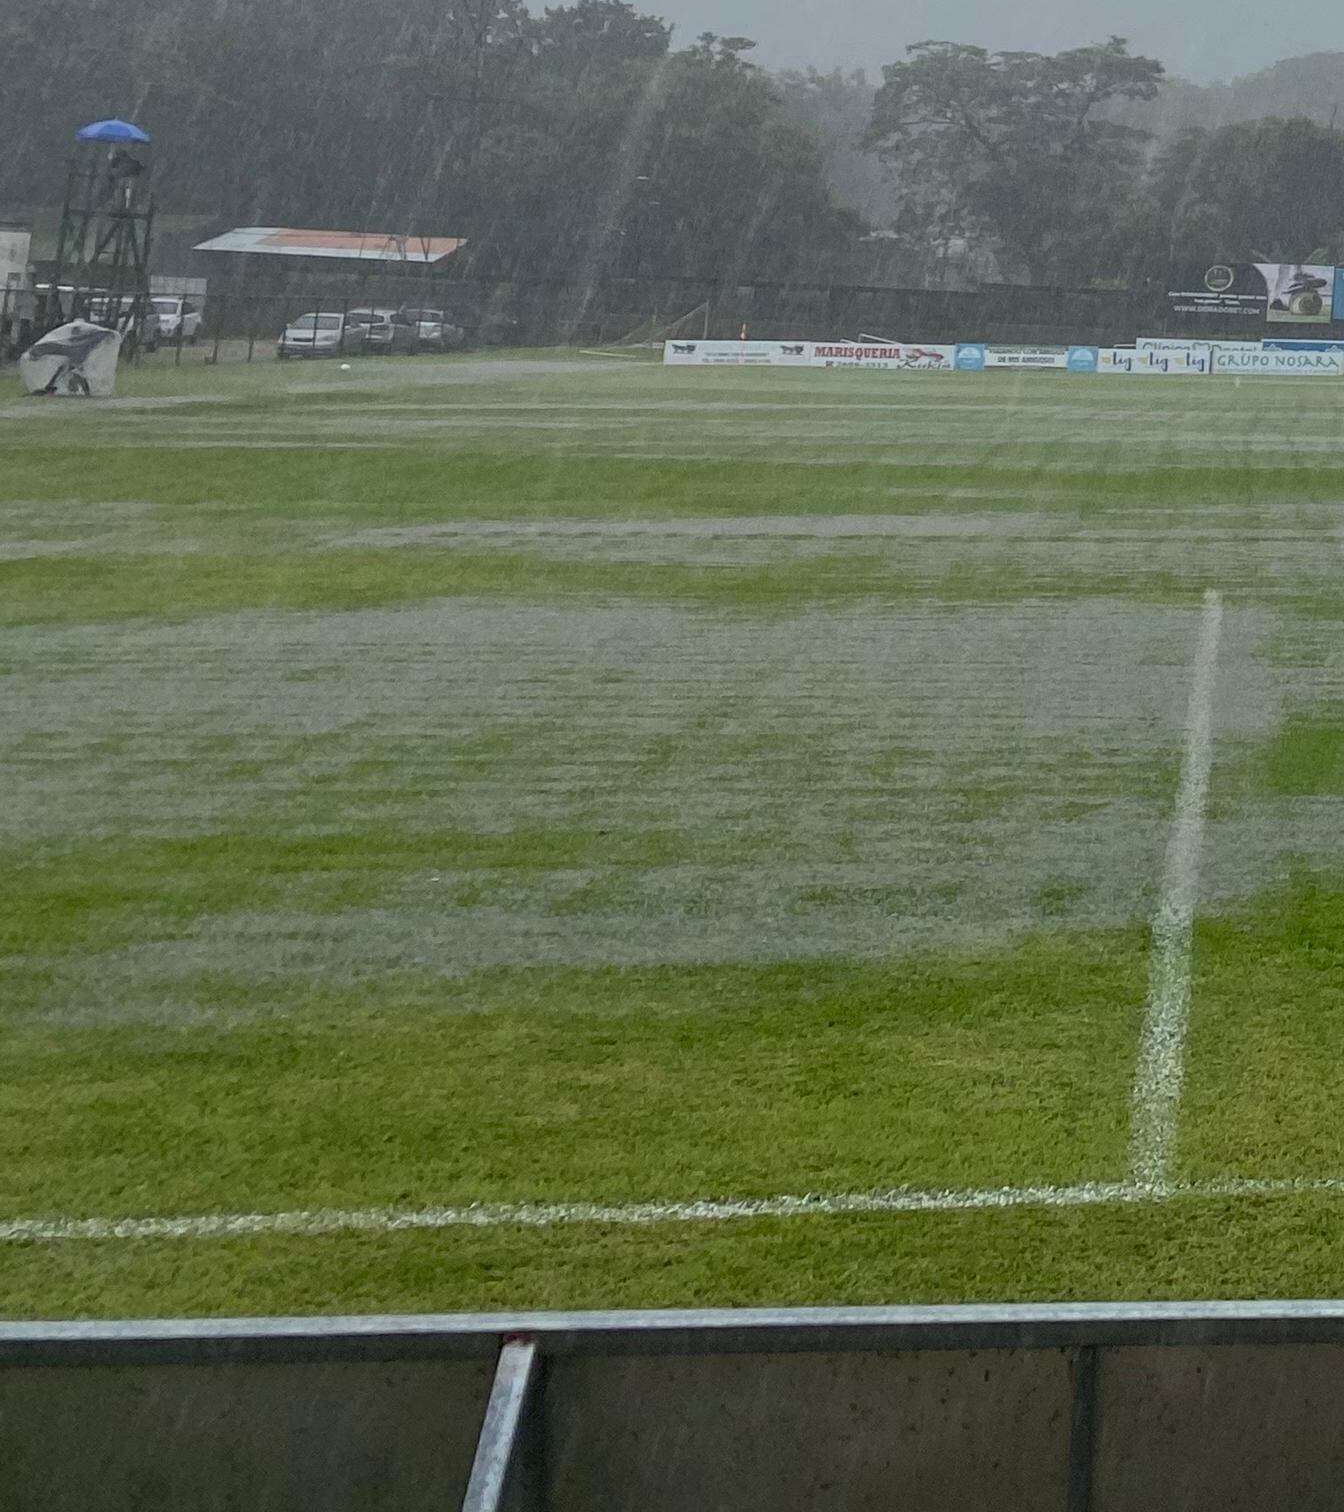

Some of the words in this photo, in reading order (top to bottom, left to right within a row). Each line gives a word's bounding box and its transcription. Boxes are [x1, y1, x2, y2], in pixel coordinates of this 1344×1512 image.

[814, 346, 901, 360] MARISQUERIA
[1217, 354, 1270, 367] GRUPO
[1275, 355, 1340, 368] NOSARA
